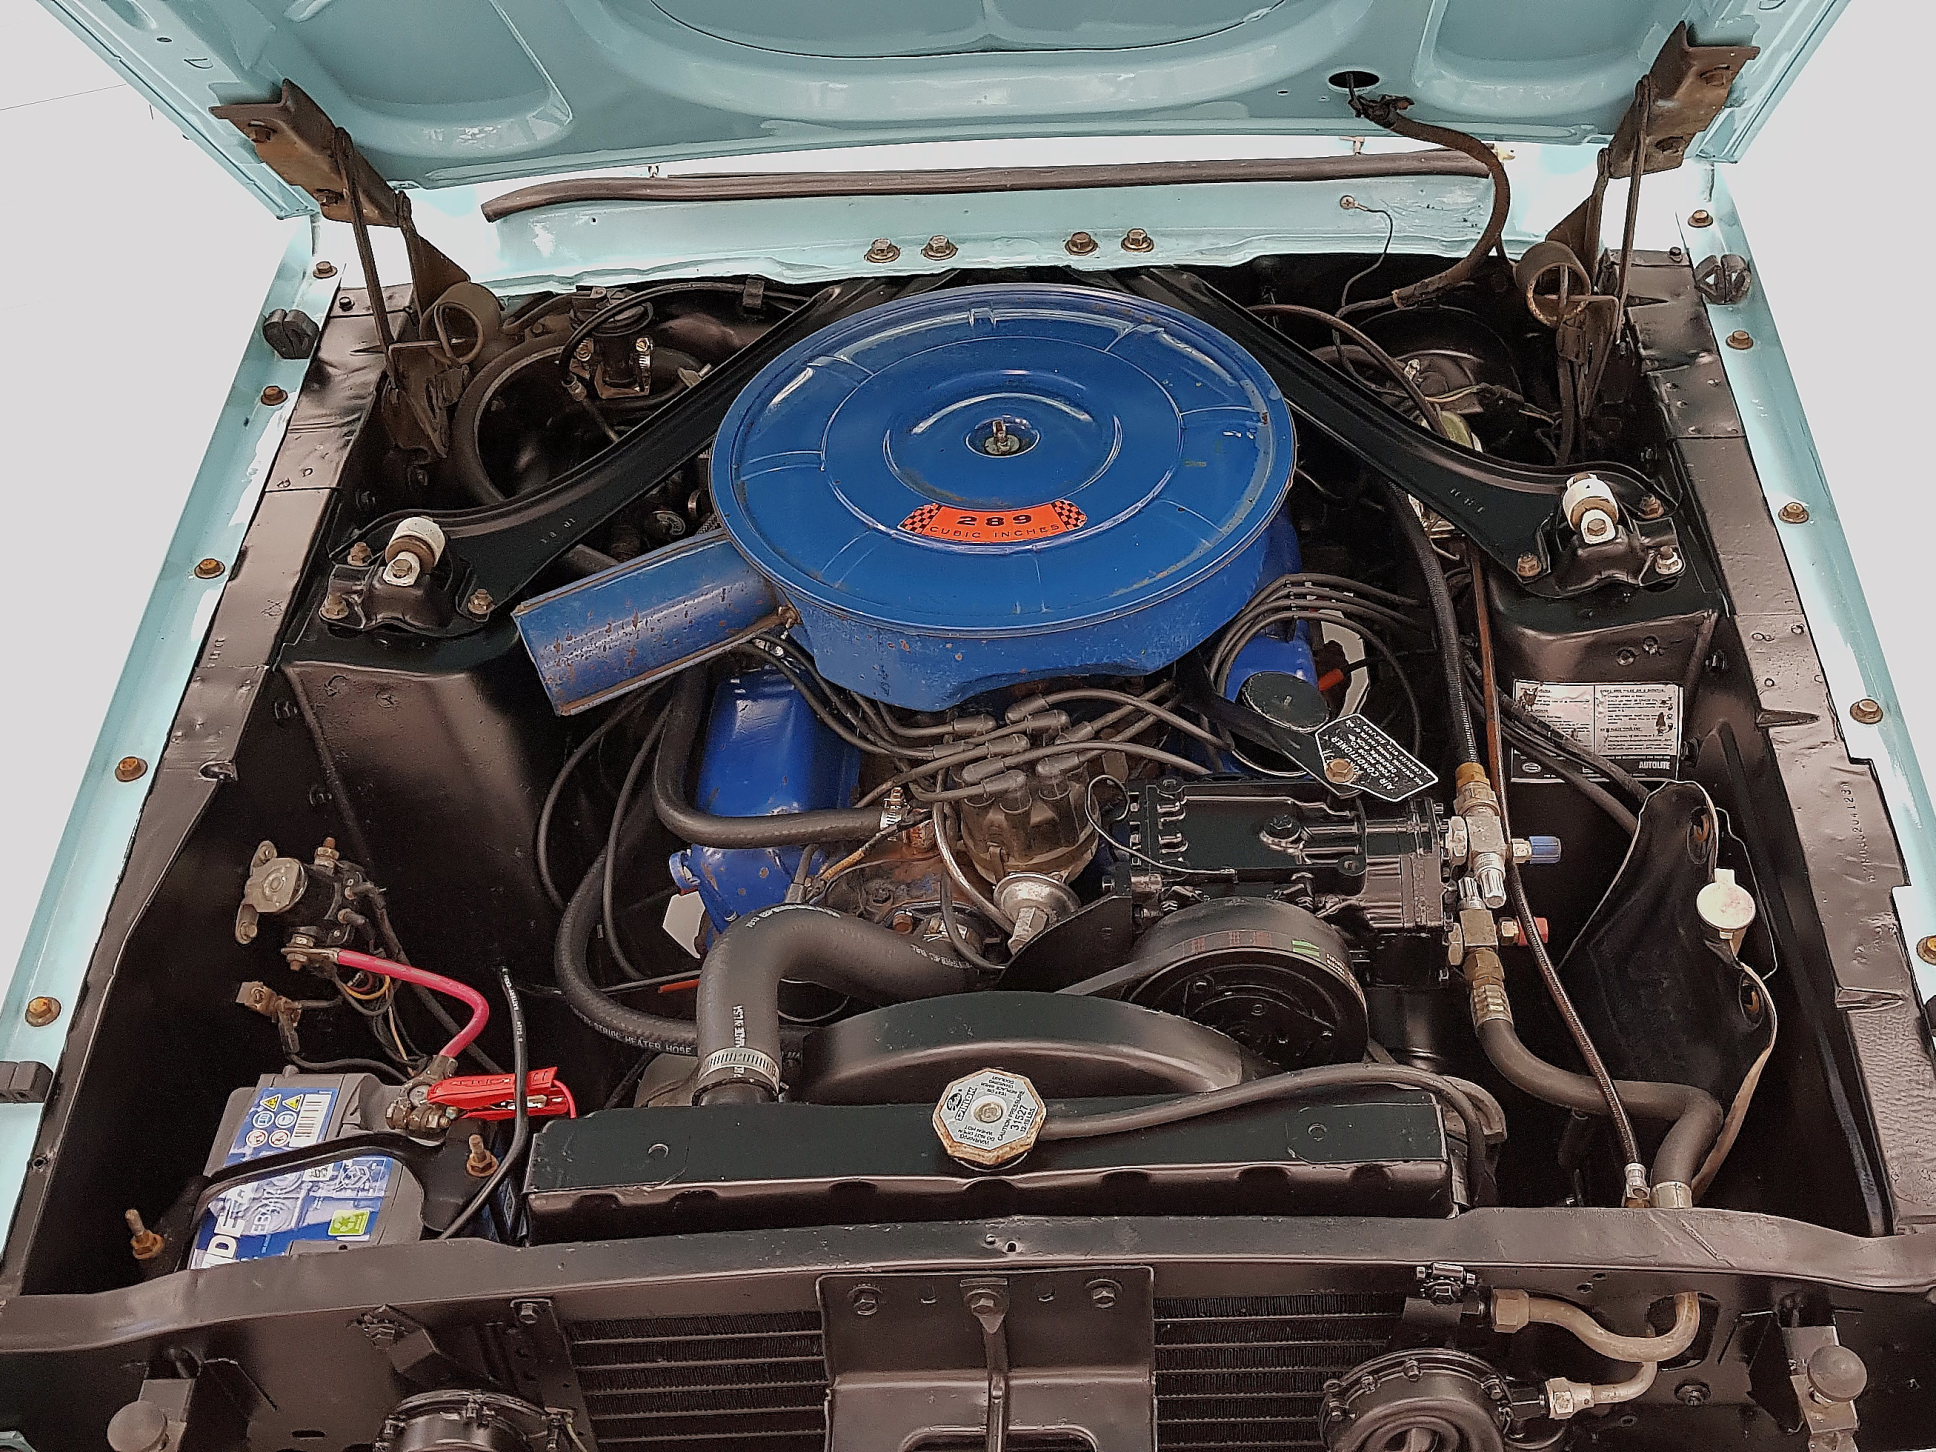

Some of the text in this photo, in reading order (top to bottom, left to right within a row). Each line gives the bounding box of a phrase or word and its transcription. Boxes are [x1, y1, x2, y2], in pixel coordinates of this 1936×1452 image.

[956, 514, 1033, 526] 289
[929, 524, 1060, 538] CUBIC INCHES
[1331, 736, 1379, 777] CONDITIONER
[1638, 761, 1671, 770] AUTOLITE
[1379, 778, 1395, 790] AIR
[1010, 1104, 1028, 1131] 31527
[997, 1118, 1011, 1141] CAUTION
